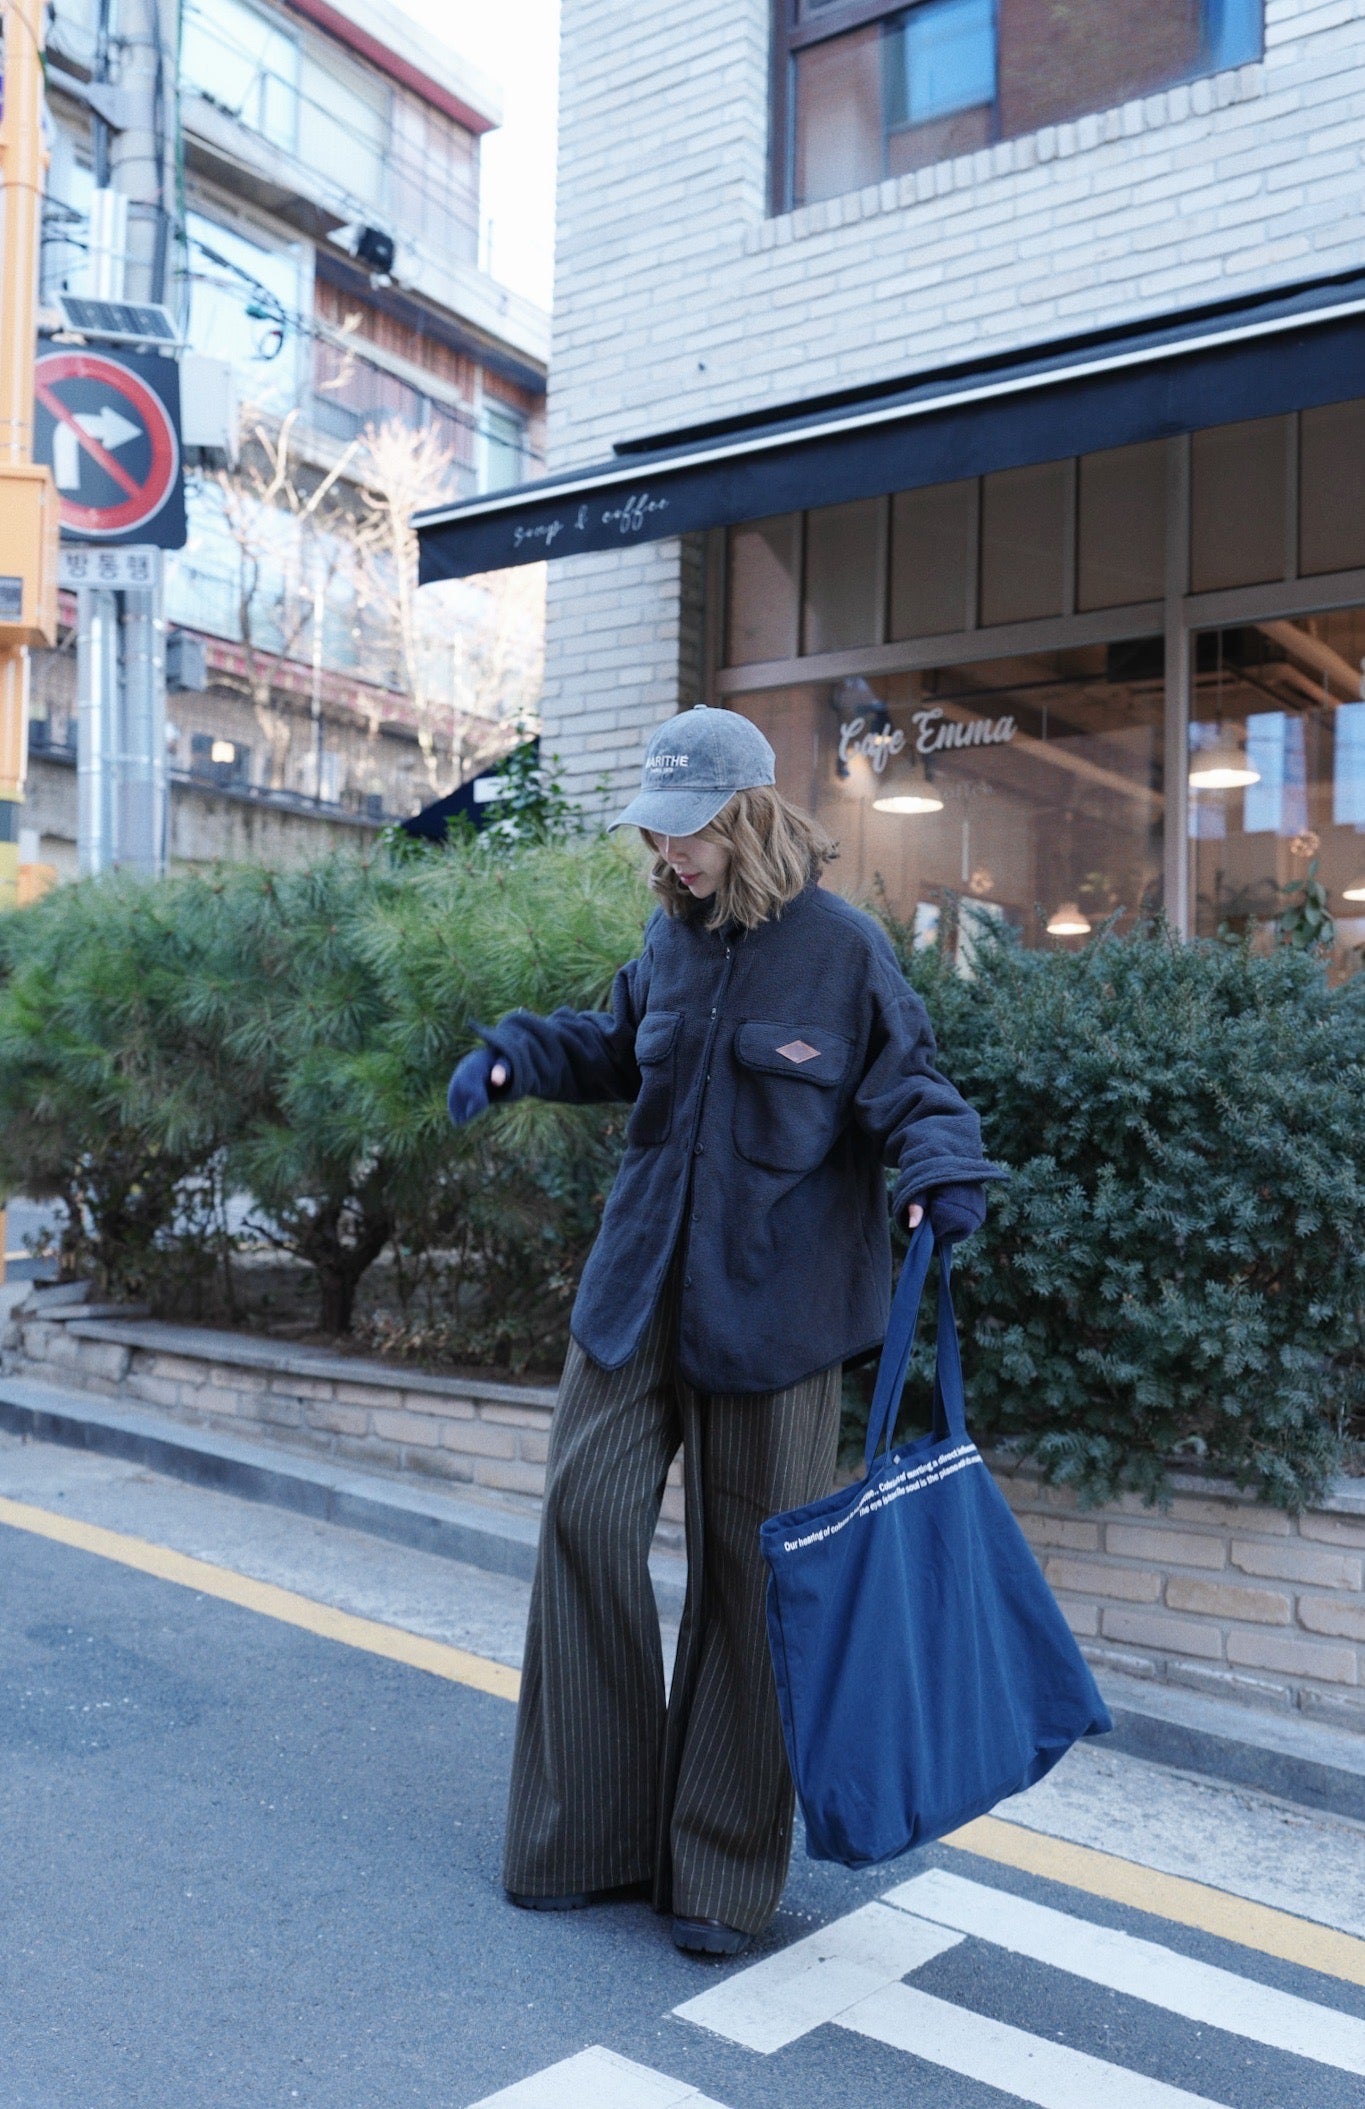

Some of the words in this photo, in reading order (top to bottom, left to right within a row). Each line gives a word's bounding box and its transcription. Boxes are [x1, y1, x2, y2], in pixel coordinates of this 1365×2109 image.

[601, 493, 669, 534] coffee
[911, 706, 1018, 754] Emma
[784, 1540, 798, 1552] Our
[798, 1529, 824, 1548] hearing
[823, 1525, 830, 1537] of
[932, 1460, 938, 1468] a
[938, 1449, 957, 1465] direct
[870, 1499, 883, 1511] eye
[905, 1480, 920, 1493] soul
[919, 1478, 927, 1488] is
[926, 1473, 939, 1484] the
[939, 1463, 959, 1480] piano
